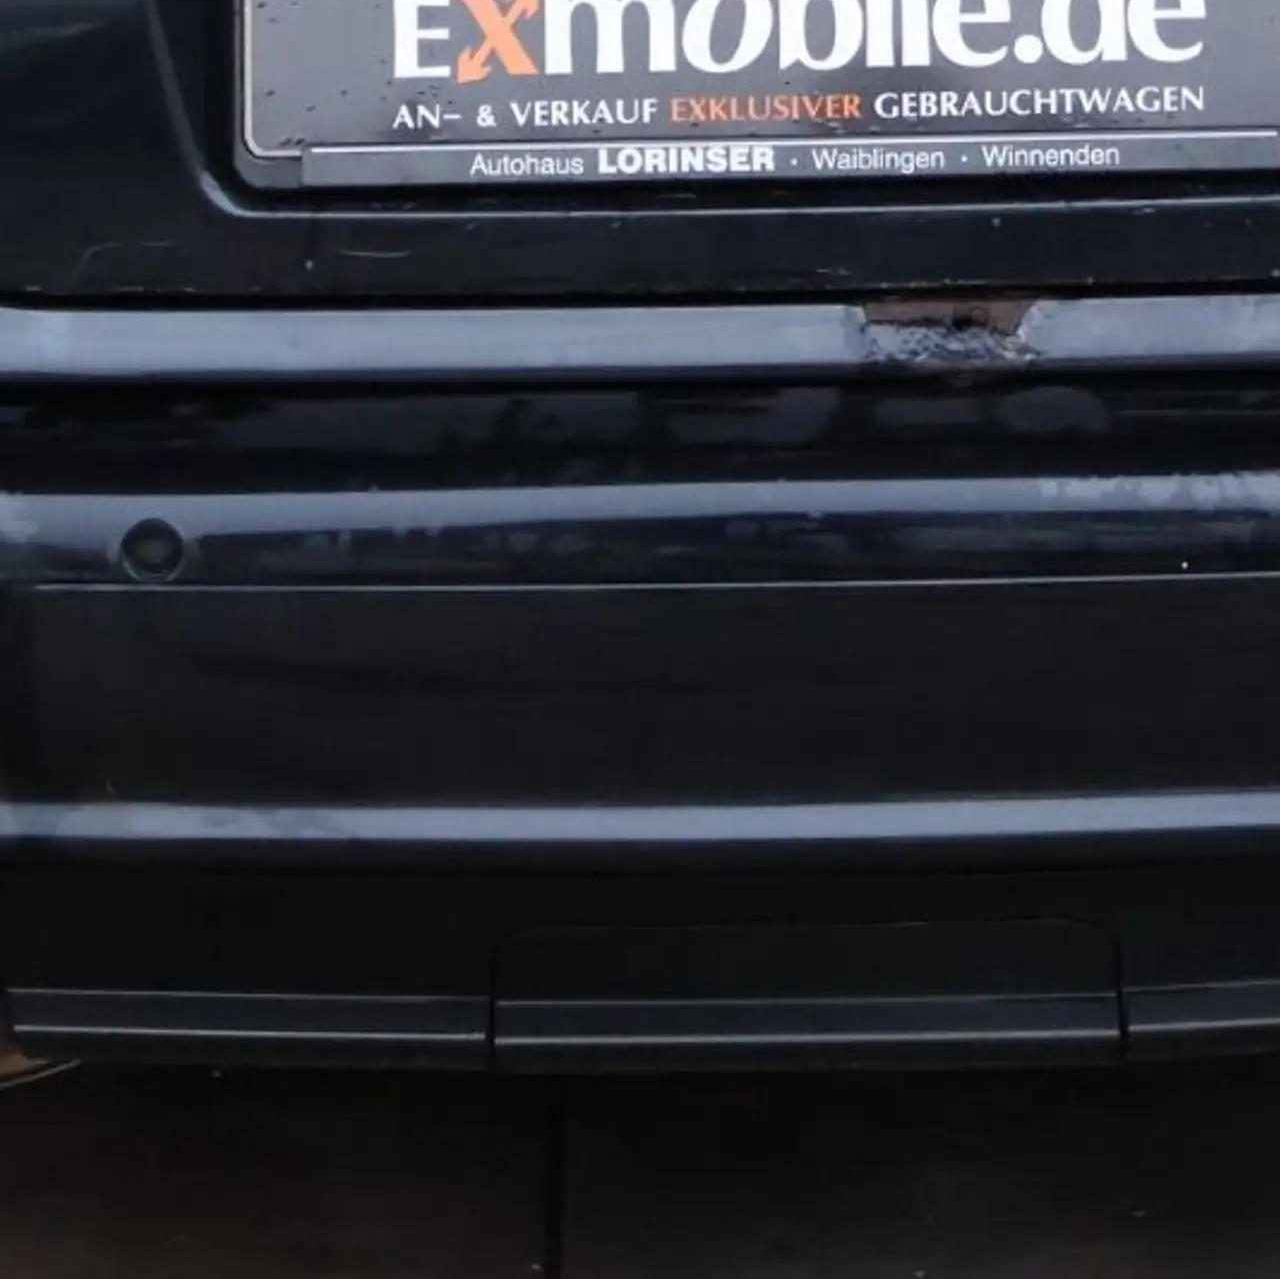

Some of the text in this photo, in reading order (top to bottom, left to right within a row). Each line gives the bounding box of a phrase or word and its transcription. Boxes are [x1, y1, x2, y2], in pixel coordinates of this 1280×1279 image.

[476, 103, 497, 127] &
[510, 97, 658, 126] VERKAUF
[670, 93, 862, 122] EXKLUSIVER
[874, 85, 1206, 119] GEBRAUCHTWAGEN
[469, 143, 1121, 177] Autohaus LORINSER Waiblingen Winnenden
